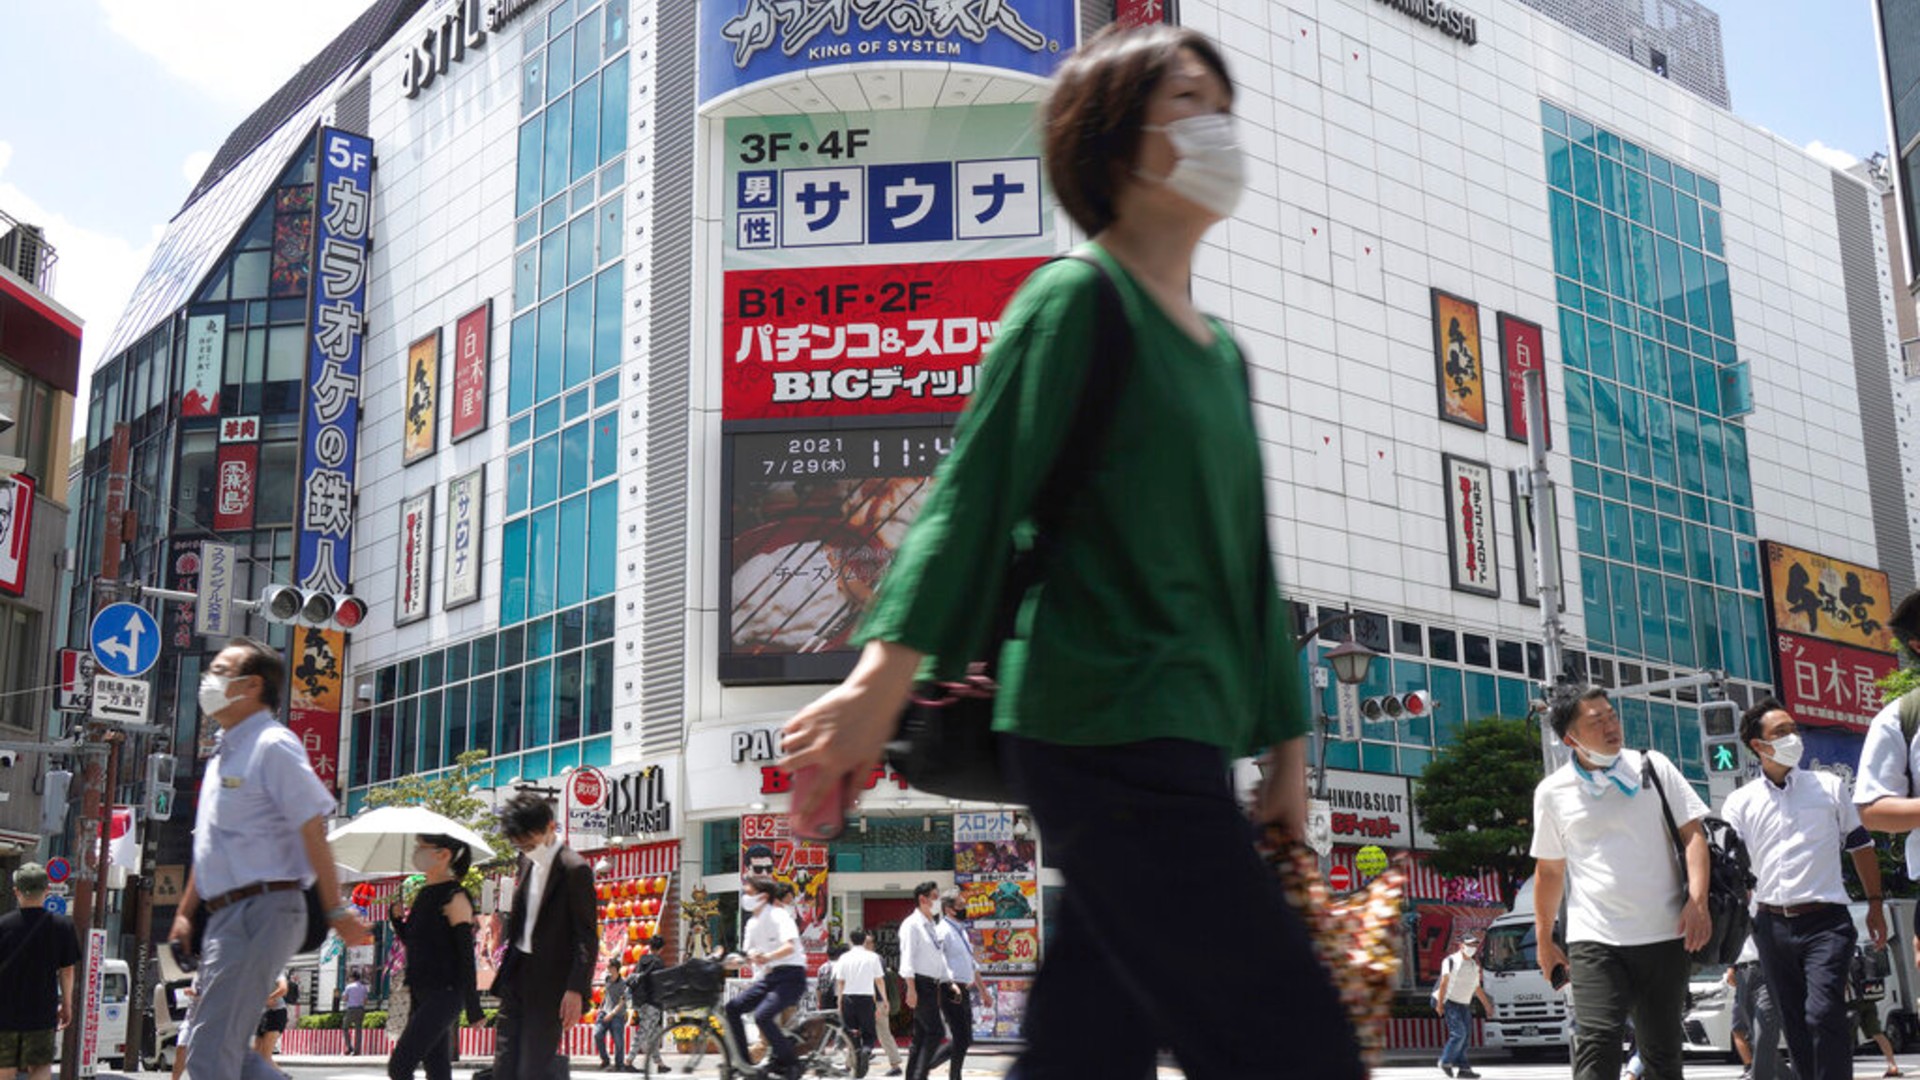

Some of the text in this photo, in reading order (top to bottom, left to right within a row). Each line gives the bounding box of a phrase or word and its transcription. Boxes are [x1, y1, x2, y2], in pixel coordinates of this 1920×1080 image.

[808, 39, 961, 60] KING OF SYSTEM
[328, 136, 367, 173] 5F
[743, 175, 772, 246] 男性
[795, 172, 1026, 233] サウナ
[735, 316, 1000, 364] パチンコ&スロッ
[300, 176, 370, 596] カラオケの鉄人
[463, 325, 484, 418] 白木屋
[788, 438, 844, 453] 2021
[1794, 646, 1877, 712] 白木屋
[959, 812, 1012, 832] スロット
